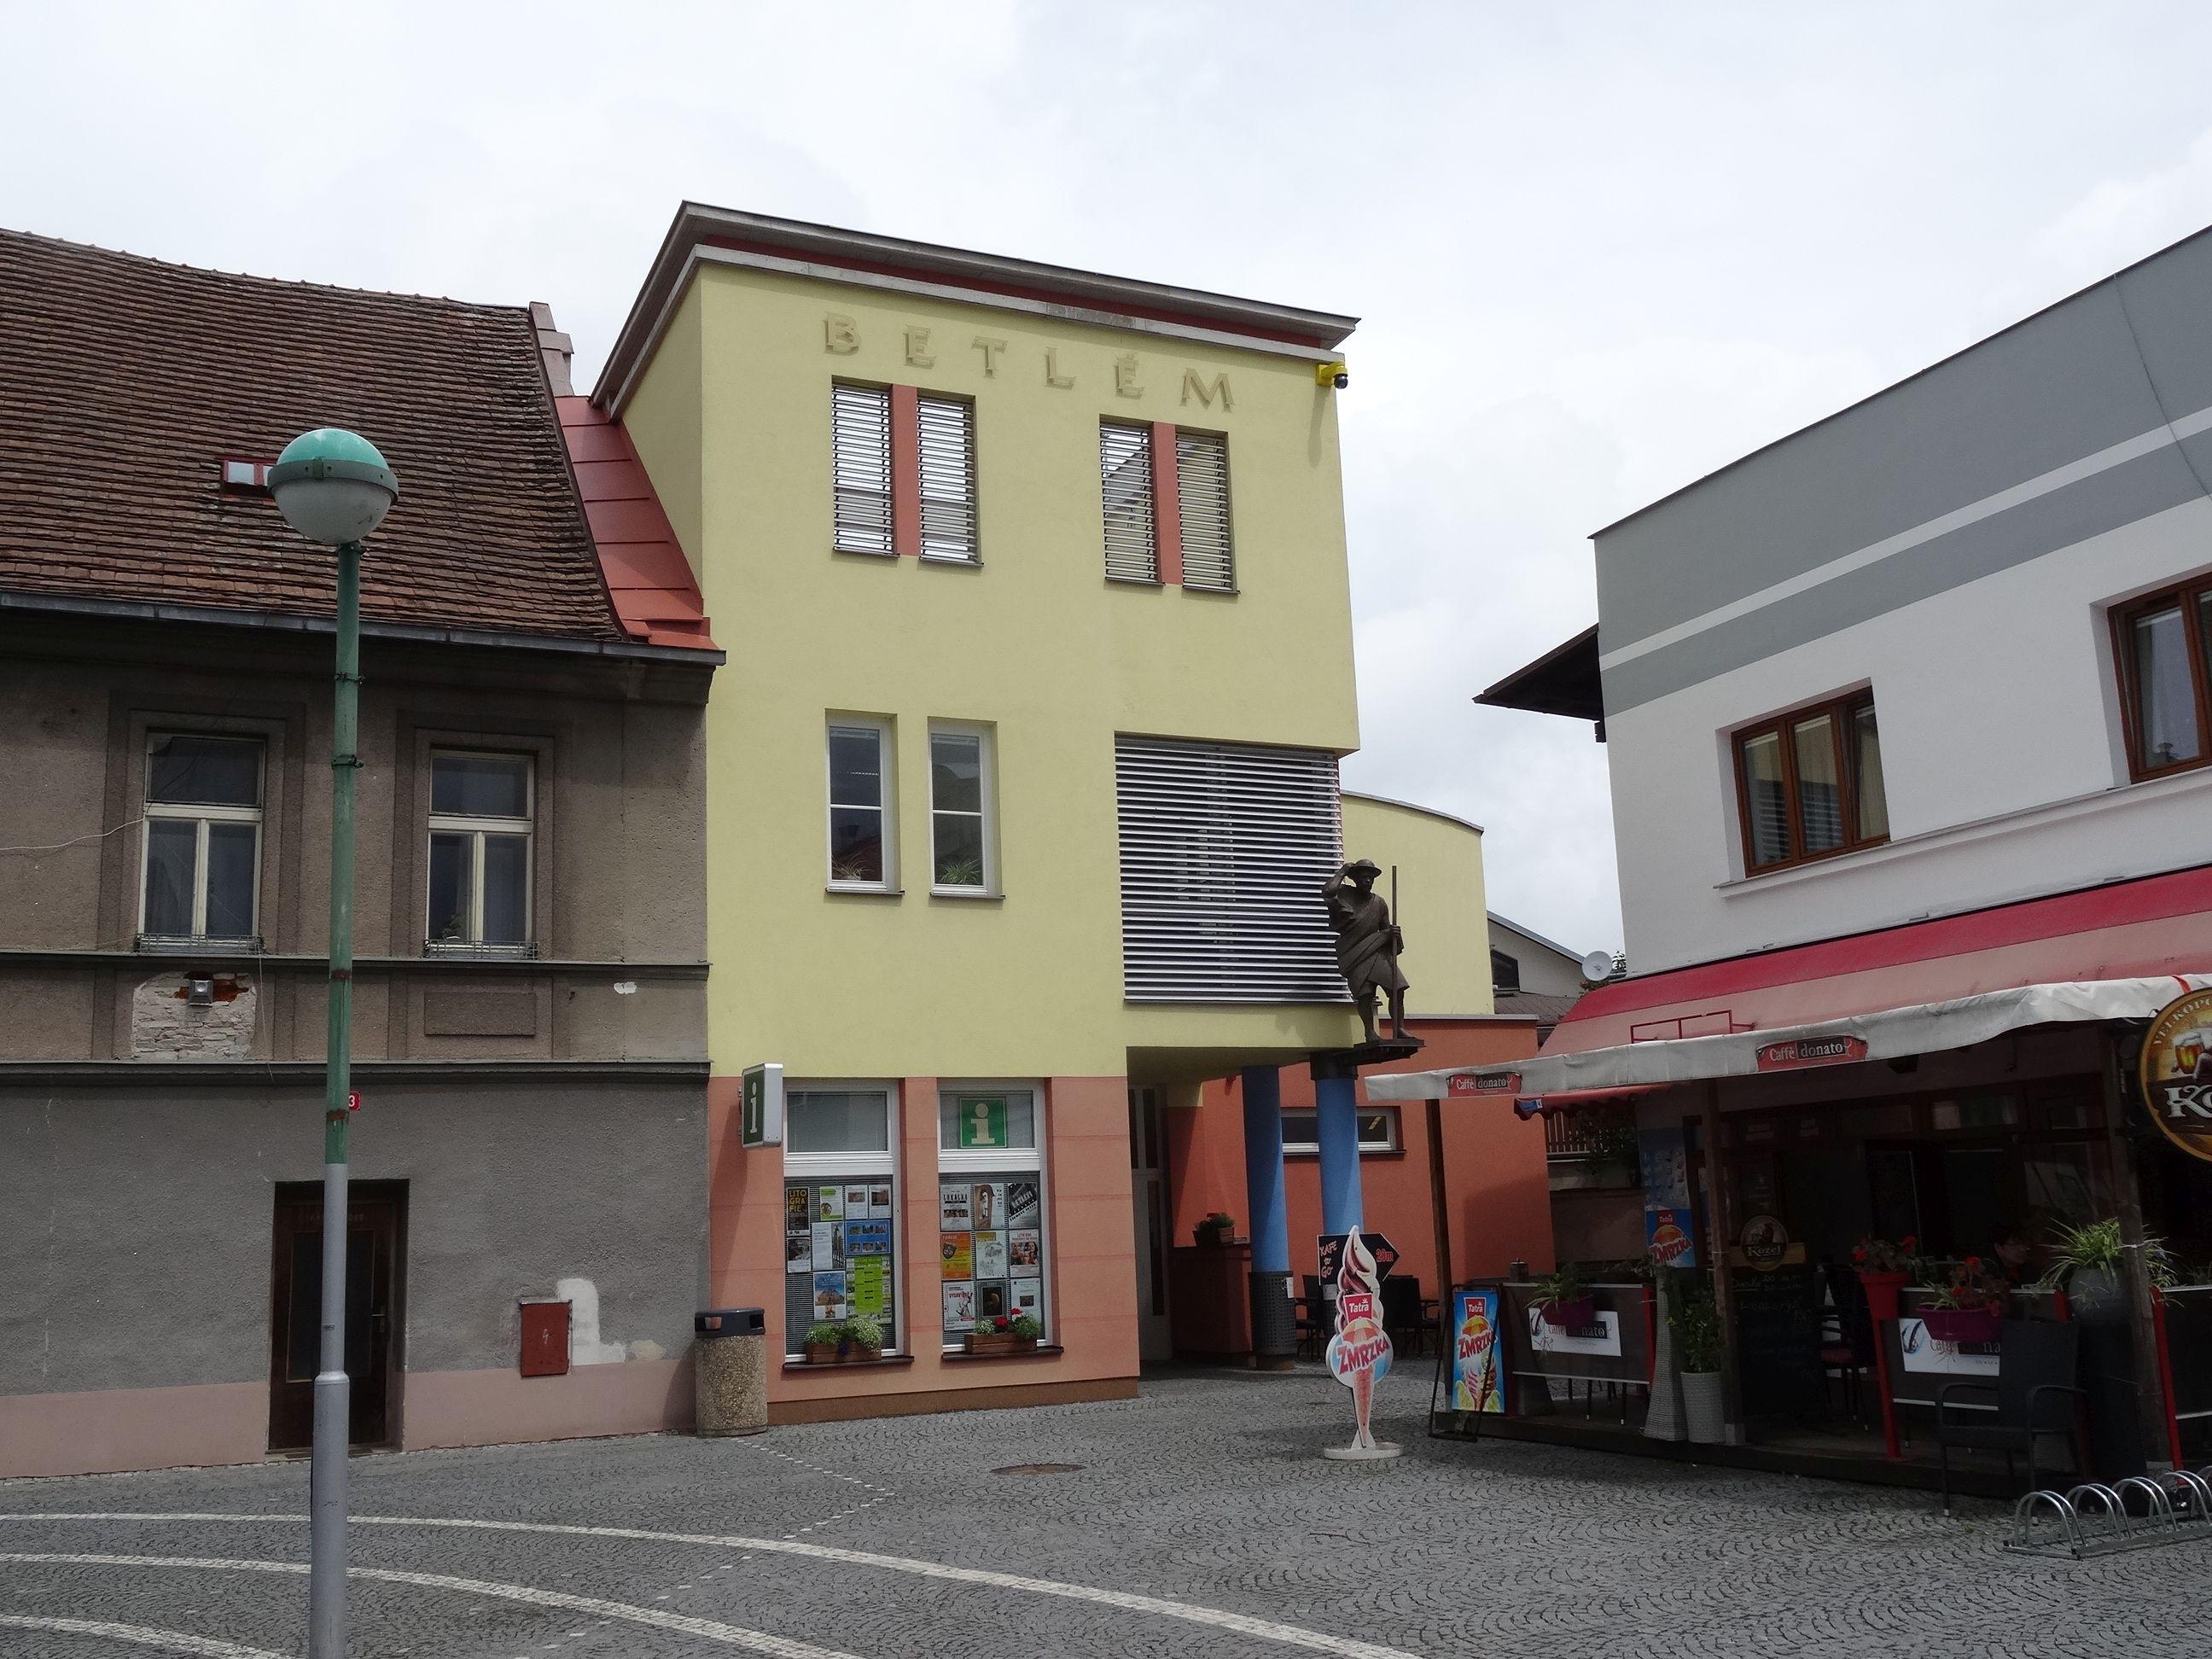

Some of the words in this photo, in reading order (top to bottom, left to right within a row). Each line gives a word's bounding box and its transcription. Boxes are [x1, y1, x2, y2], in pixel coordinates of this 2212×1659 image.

[824, 311, 1235, 412] BETLÉM
[1769, 1046, 1795, 1062] Caffè
[1800, 1042, 1843, 1058] donato
[1456, 1078, 1475, 1091] Caffè
[1477, 1078, 1507, 1089] donato
[789, 1189, 807, 1197] LITO
[1348, 1302, 1370, 1313] Tatra
[1468, 1304, 1483, 1313] Tatra
[1336, 1337, 1391, 1376] ZMRZKA
